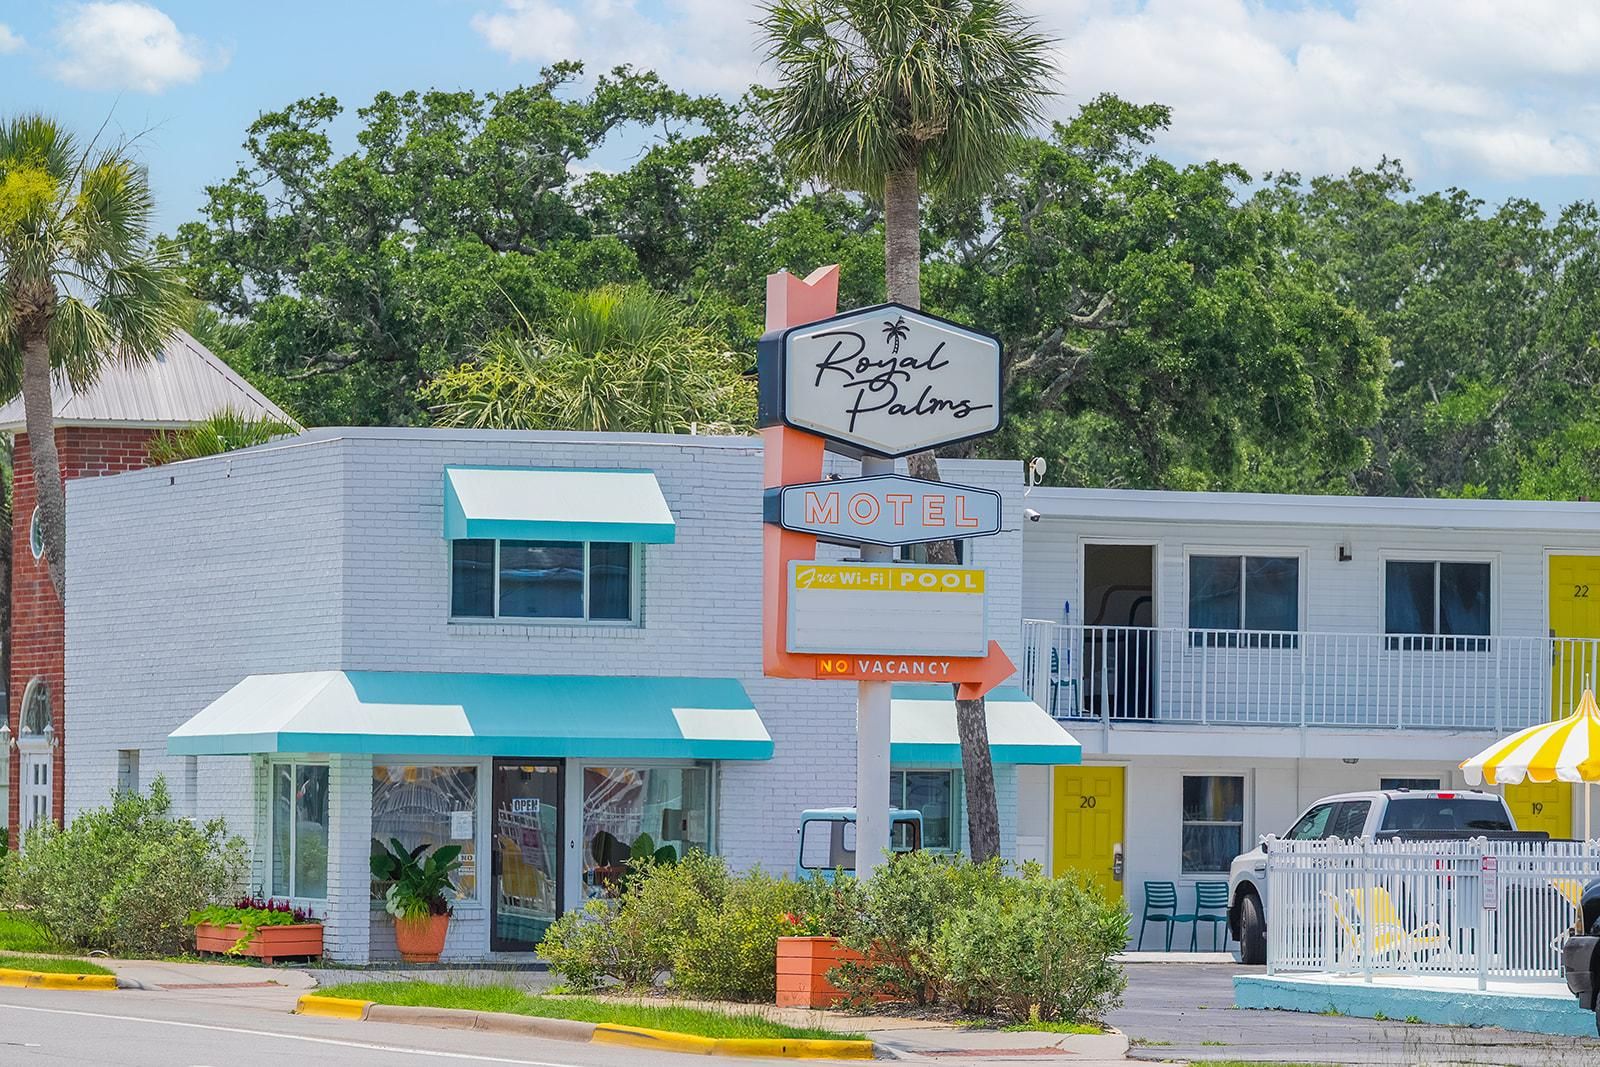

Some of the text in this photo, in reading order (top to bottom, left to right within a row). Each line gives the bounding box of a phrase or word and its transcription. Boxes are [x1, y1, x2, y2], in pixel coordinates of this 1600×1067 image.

[811, 331, 949, 392] Royal
[842, 379, 993, 433] Palms
[805, 491, 978, 528] MOTEL
[797, 567, 977, 590] Free Wi-Fi POOL
[1574, 584, 1589, 598] 22
[820, 659, 950, 675] NO VACANCY
[514, 799, 539, 812] OPEN
[1080, 795, 1097, 809] 20
[1532, 802, 1544, 815] 19
